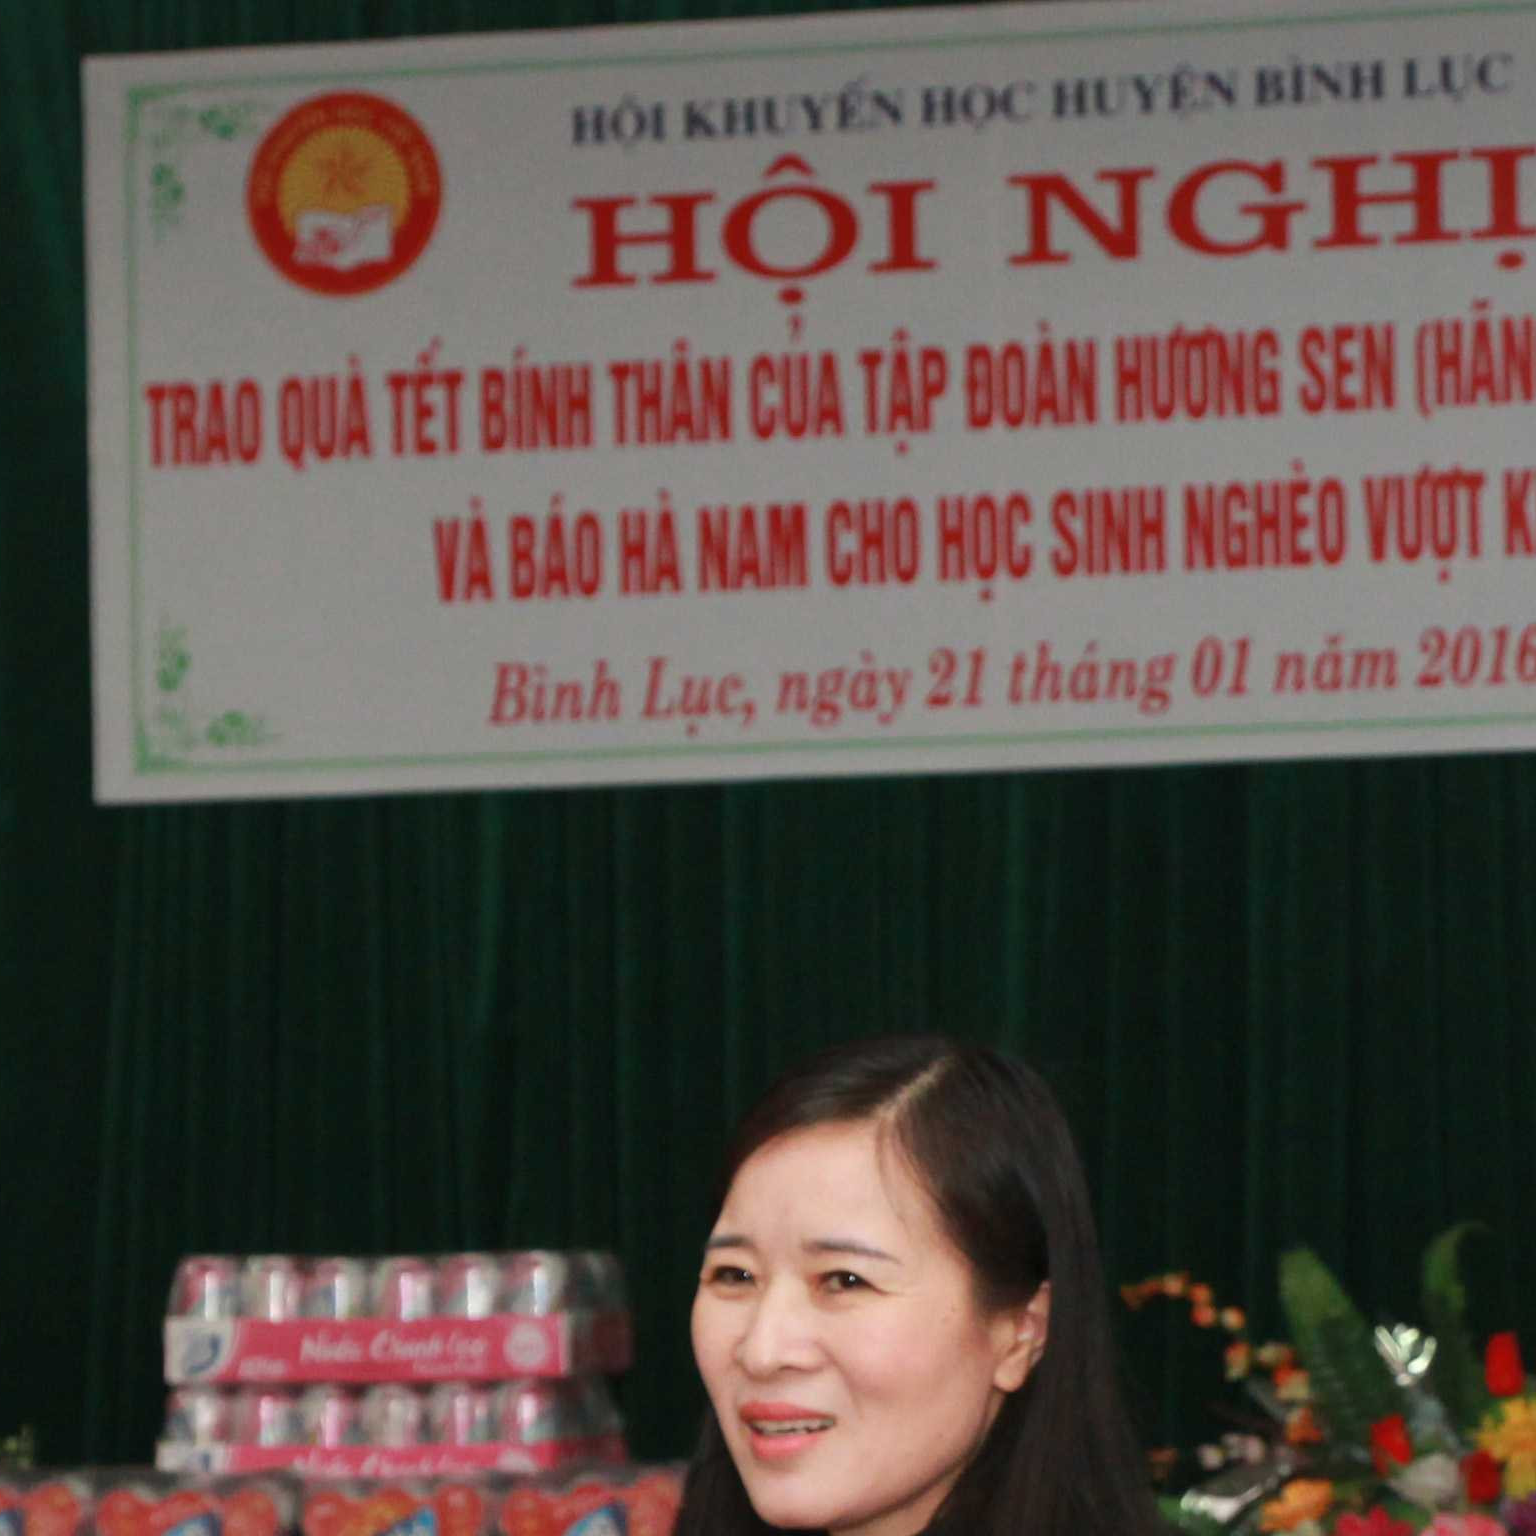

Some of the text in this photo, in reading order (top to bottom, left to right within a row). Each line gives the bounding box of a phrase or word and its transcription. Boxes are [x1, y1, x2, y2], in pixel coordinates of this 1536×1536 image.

[572, 51, 1515, 152] HỘI KHUYẾN HỌC HUYỆN BÌNH LỤC
[570, 152, 939, 306] HỘI
[144, 377, 263, 468] TRAO
[277, 352, 372, 471] QUÀ
[385, 335, 465, 457] TẾT
[479, 344, 595, 454] BÍNH
[608, 337, 732, 446] THÂN
[748, 314, 846, 441] CỦA
[858, 327, 947, 456] TẬP
[965, 319, 1099, 430] ĐOÀN
[1113, 320, 1281, 423] HƯƠNG
[1297, 321, 1395, 414] SEN
[432, 495, 494, 604] VÀ
[508, 491, 601, 600] BÁO
[618, 487, 682, 594] HÀ
[696, 501, 809, 593] NAM
[824, 495, 920, 587] CHO
[936, 489, 1033, 603] HỌC
[1049, 485, 1166, 579] SINH
[1182, 457, 1348, 571] NGHÈO
[1362, 463, 1486, 585] VƯỢT
[639, 655, 757, 737] Lục,
[775, 649, 914, 728] ngày
[924, 644, 989, 710] 21
[1006, 639, 1179, 716] tháng
[1191, 633, 1255, 700] 01
[1271, 633, 1398, 696] năm
